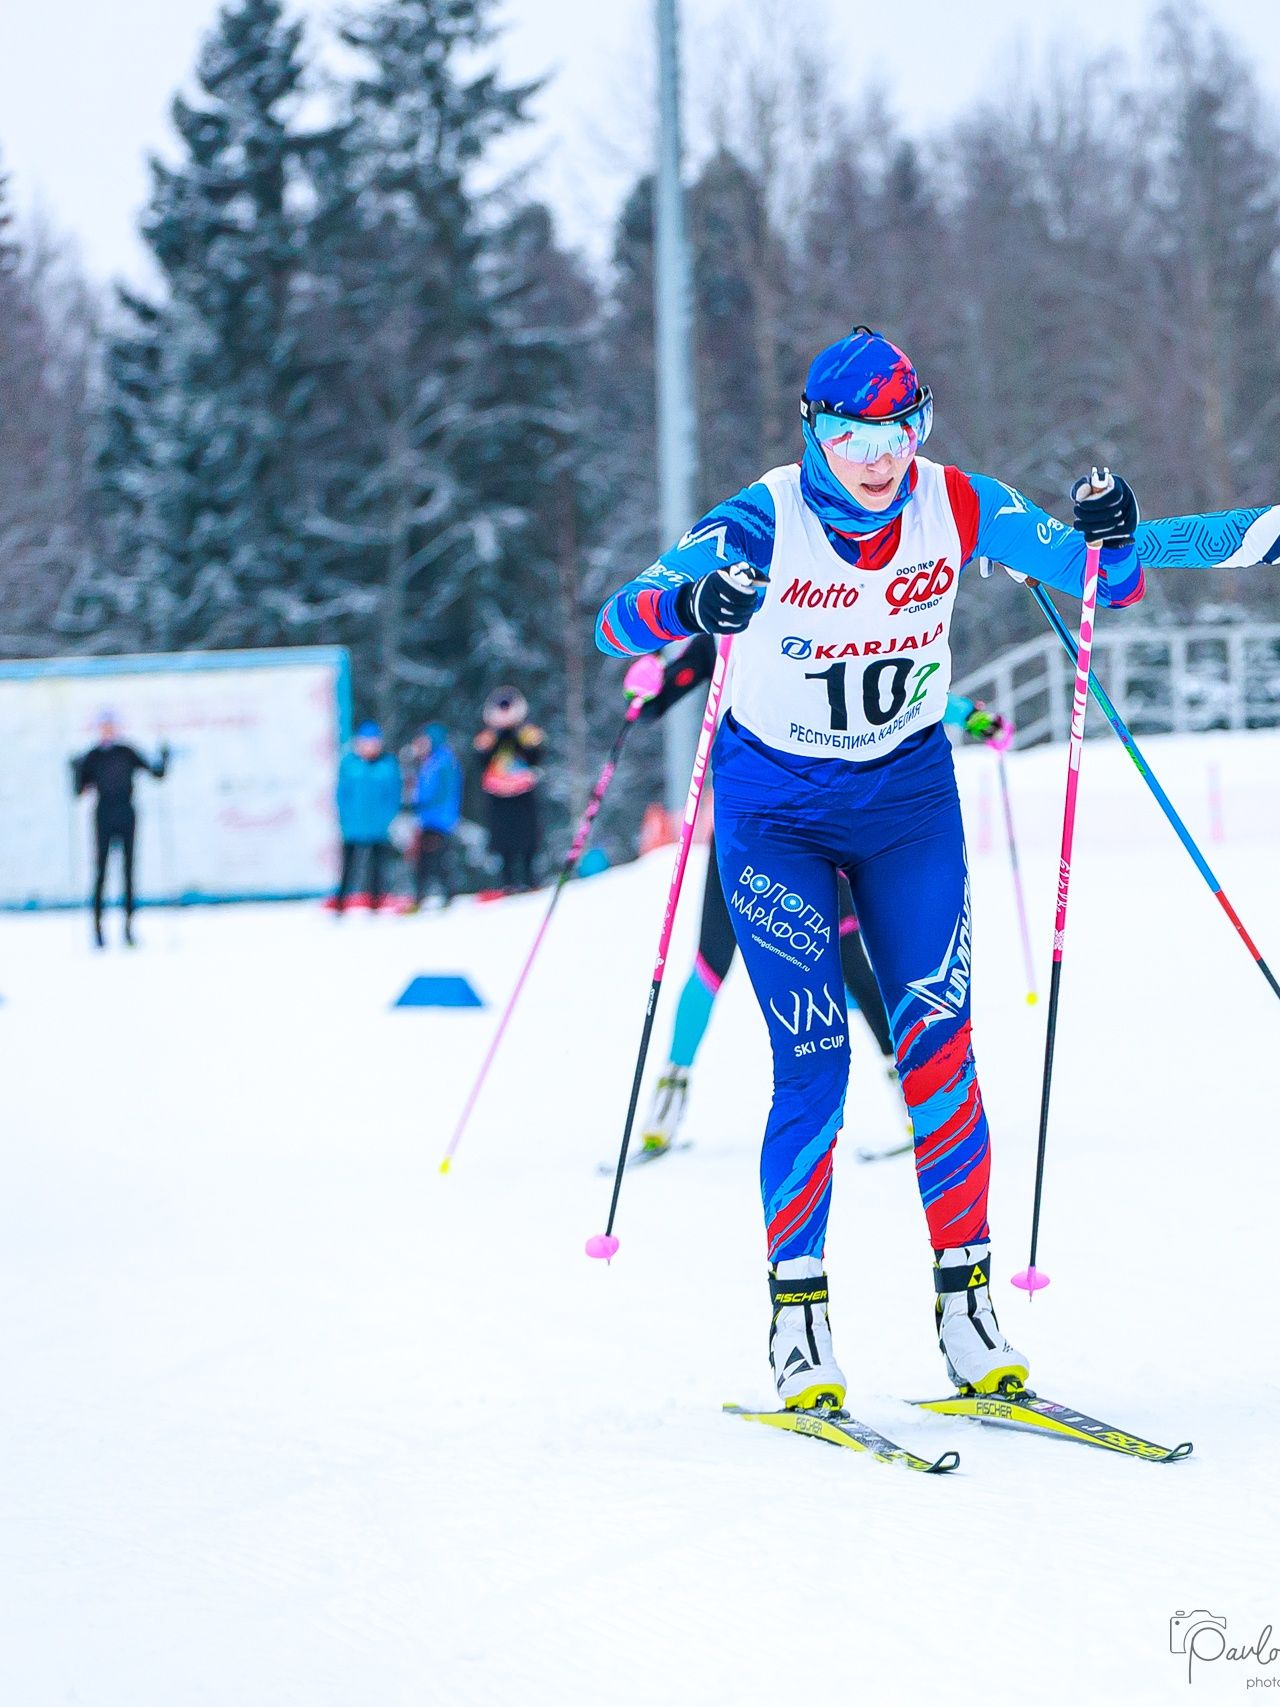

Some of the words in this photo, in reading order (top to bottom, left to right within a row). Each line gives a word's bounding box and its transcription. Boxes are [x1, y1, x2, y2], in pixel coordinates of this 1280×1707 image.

[896, 565, 917, 576] ООО
[780, 578, 860, 608] Motto
[814, 622, 943, 659] KARJALA
[805, 657, 941, 731] 102
[789, 722, 876, 749] РЕСПУБЛИКА
[877, 702, 923, 742] КАРЕЛИЯ
[739, 865, 831, 943] ВОЛОГДА
[731, 890, 824, 961] МАРАФОН
[793, 1040, 817, 1058] SKI
[819, 1034, 845, 1050] CUP
[774, 1289, 828, 1303] FISCHER
[795, 1416, 823, 1434] FISCHER
[976, 1401, 1012, 1420] FISCHER
